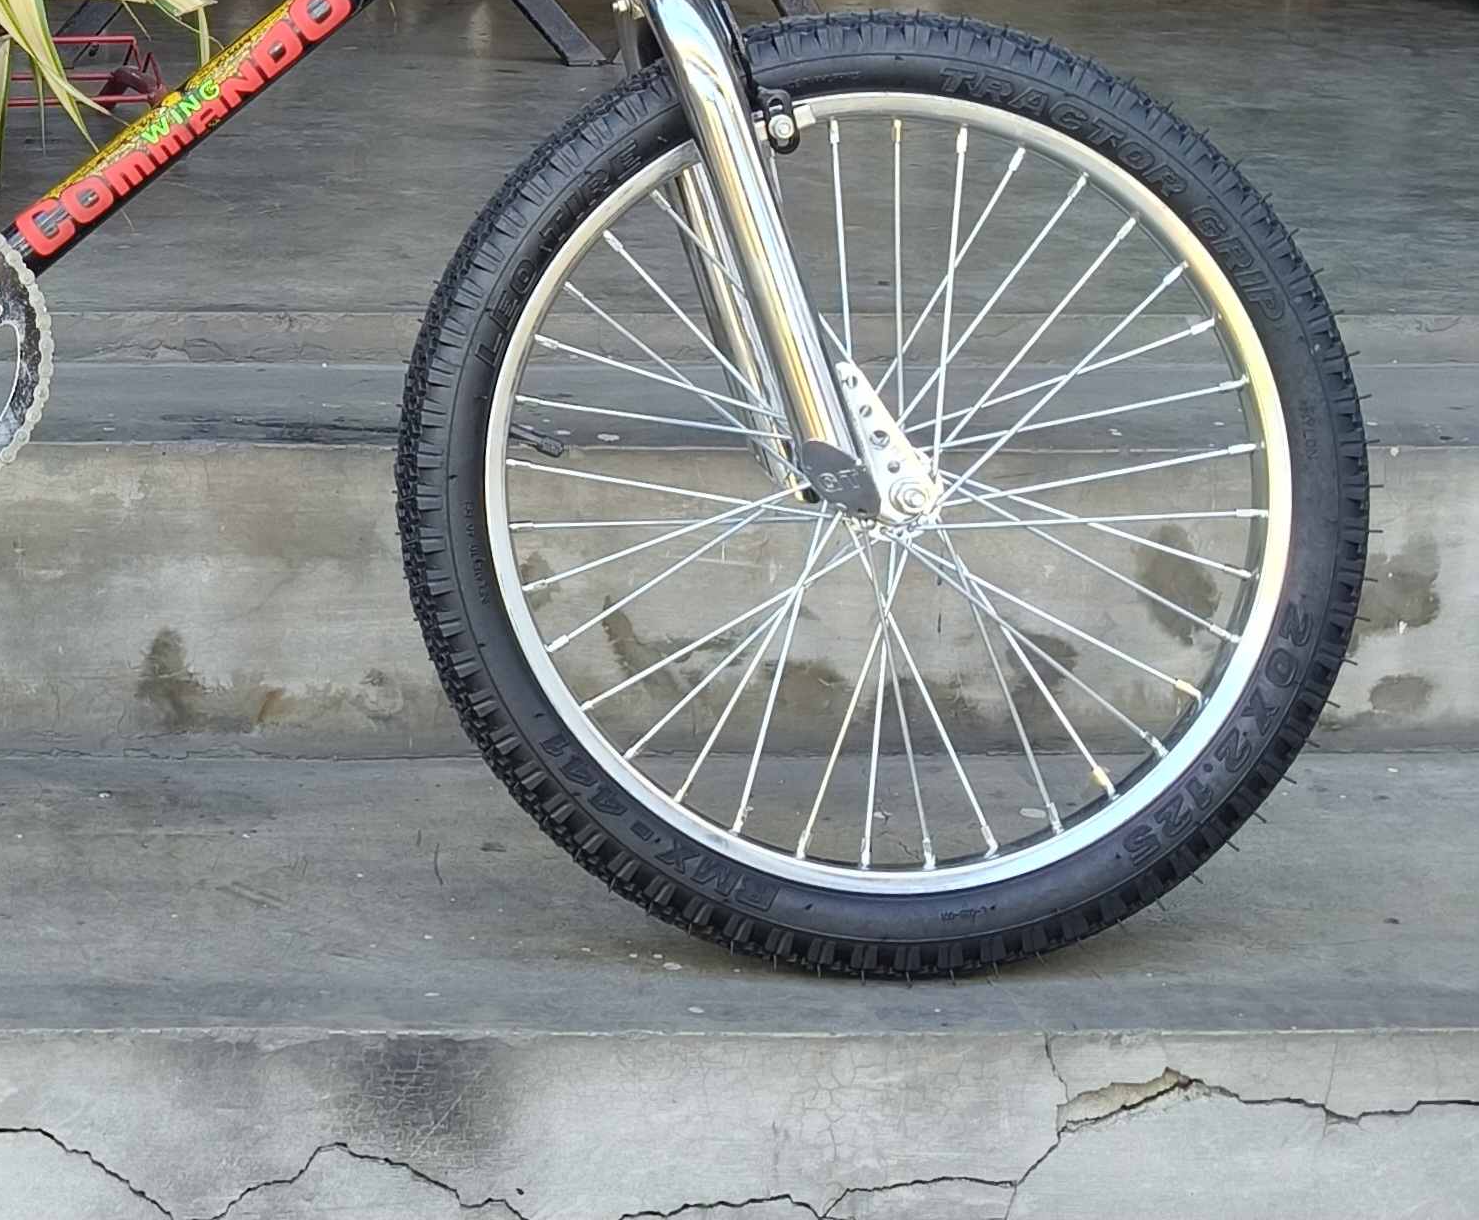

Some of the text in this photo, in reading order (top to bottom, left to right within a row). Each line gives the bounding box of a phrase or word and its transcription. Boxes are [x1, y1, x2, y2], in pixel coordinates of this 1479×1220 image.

[141, 80, 220, 144] WING
[939, 66, 1285, 323] TRACTOR GRIP
[474, 136, 642, 374] LEO TIRE
